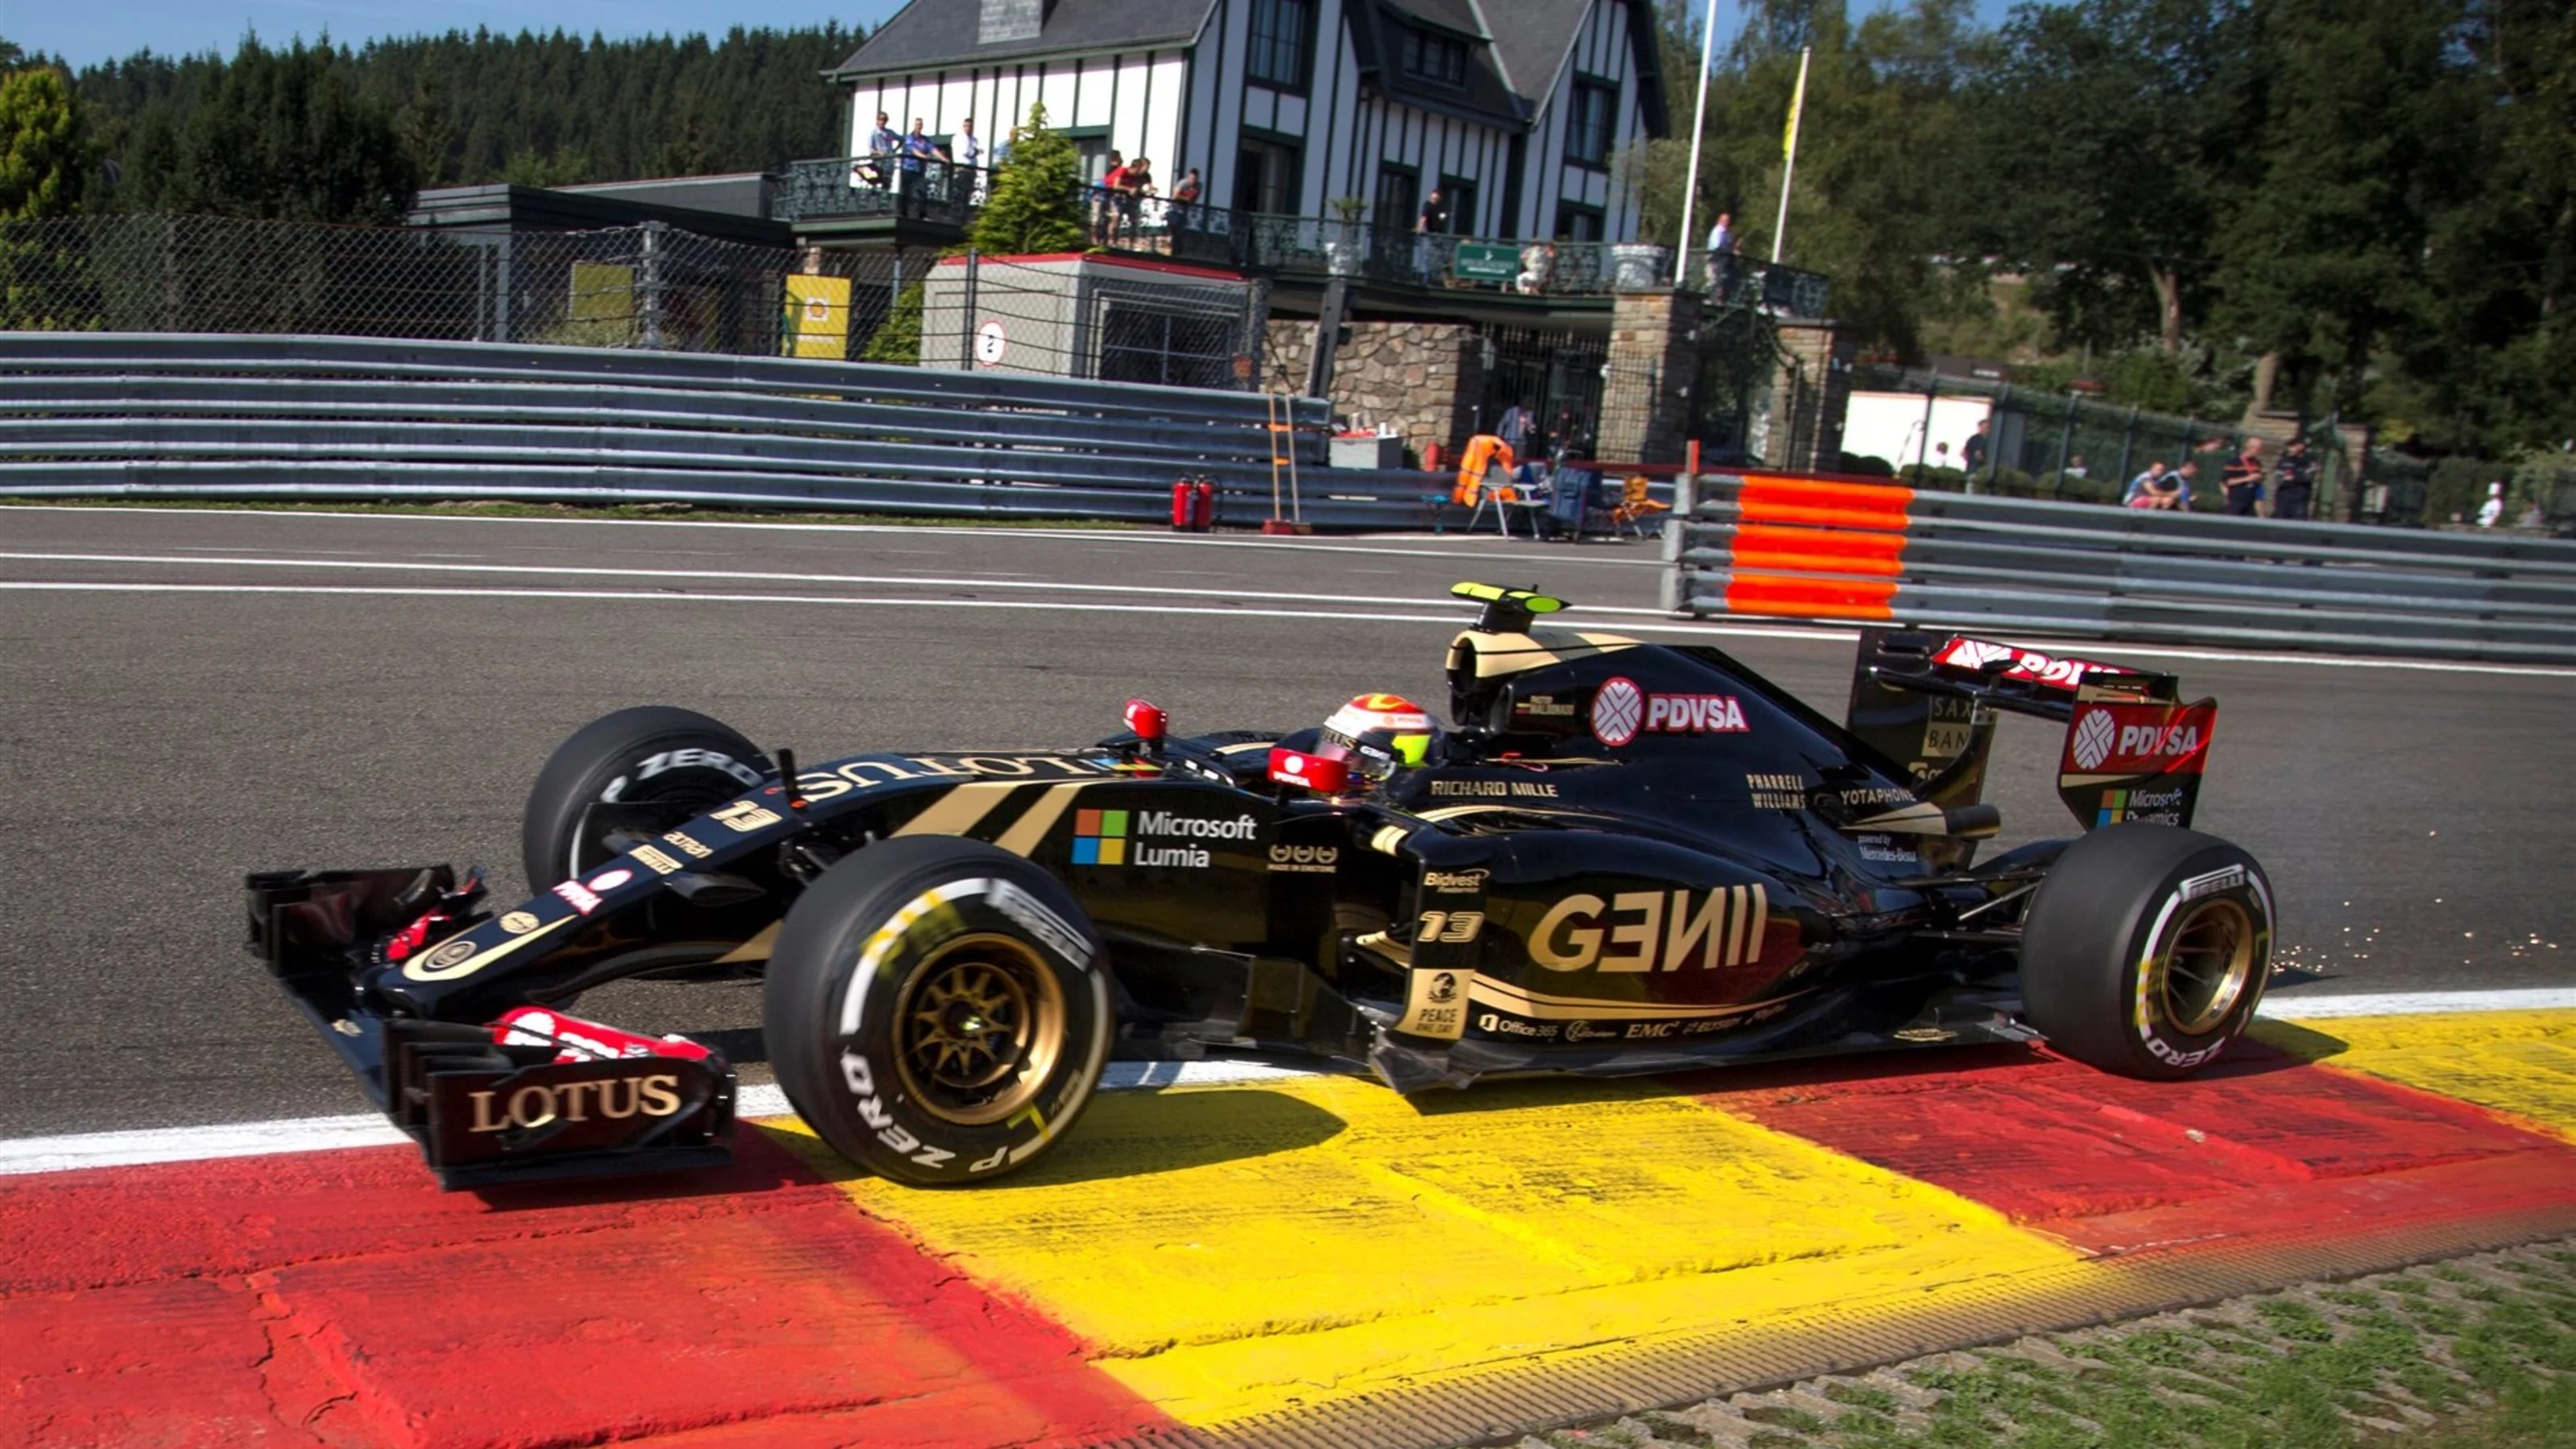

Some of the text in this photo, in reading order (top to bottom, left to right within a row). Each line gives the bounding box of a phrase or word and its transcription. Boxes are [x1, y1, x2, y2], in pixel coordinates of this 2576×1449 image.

[1646, 696, 1751, 733] PDVSA
[2118, 725, 2198, 756] PDVSA
[636, 748, 764, 787] ZERO
[796, 757, 1099, 802] LOTUS
[1746, 774, 1804, 791] PHARRELL
[1431, 780, 1559, 798] RICHARD MILLE
[1840, 789, 1917, 805] YOTAPHONE
[710, 800, 783, 832] 13
[1137, 811, 1257, 840] Microsoft
[1134, 843, 1210, 868] Lumia
[1424, 872, 1482, 886] Bidvest
[2180, 863, 2245, 902] PIRELLI
[1417, 910, 1485, 943] 13
[1418, 1008, 1458, 1022] PEACE
[1499, 1020, 1537, 1036] Office
[2145, 1036, 2227, 1068] ZERO
[465, 1075, 682, 1133] LOTUS
[840, 1051, 1007, 1172] P ZERO
